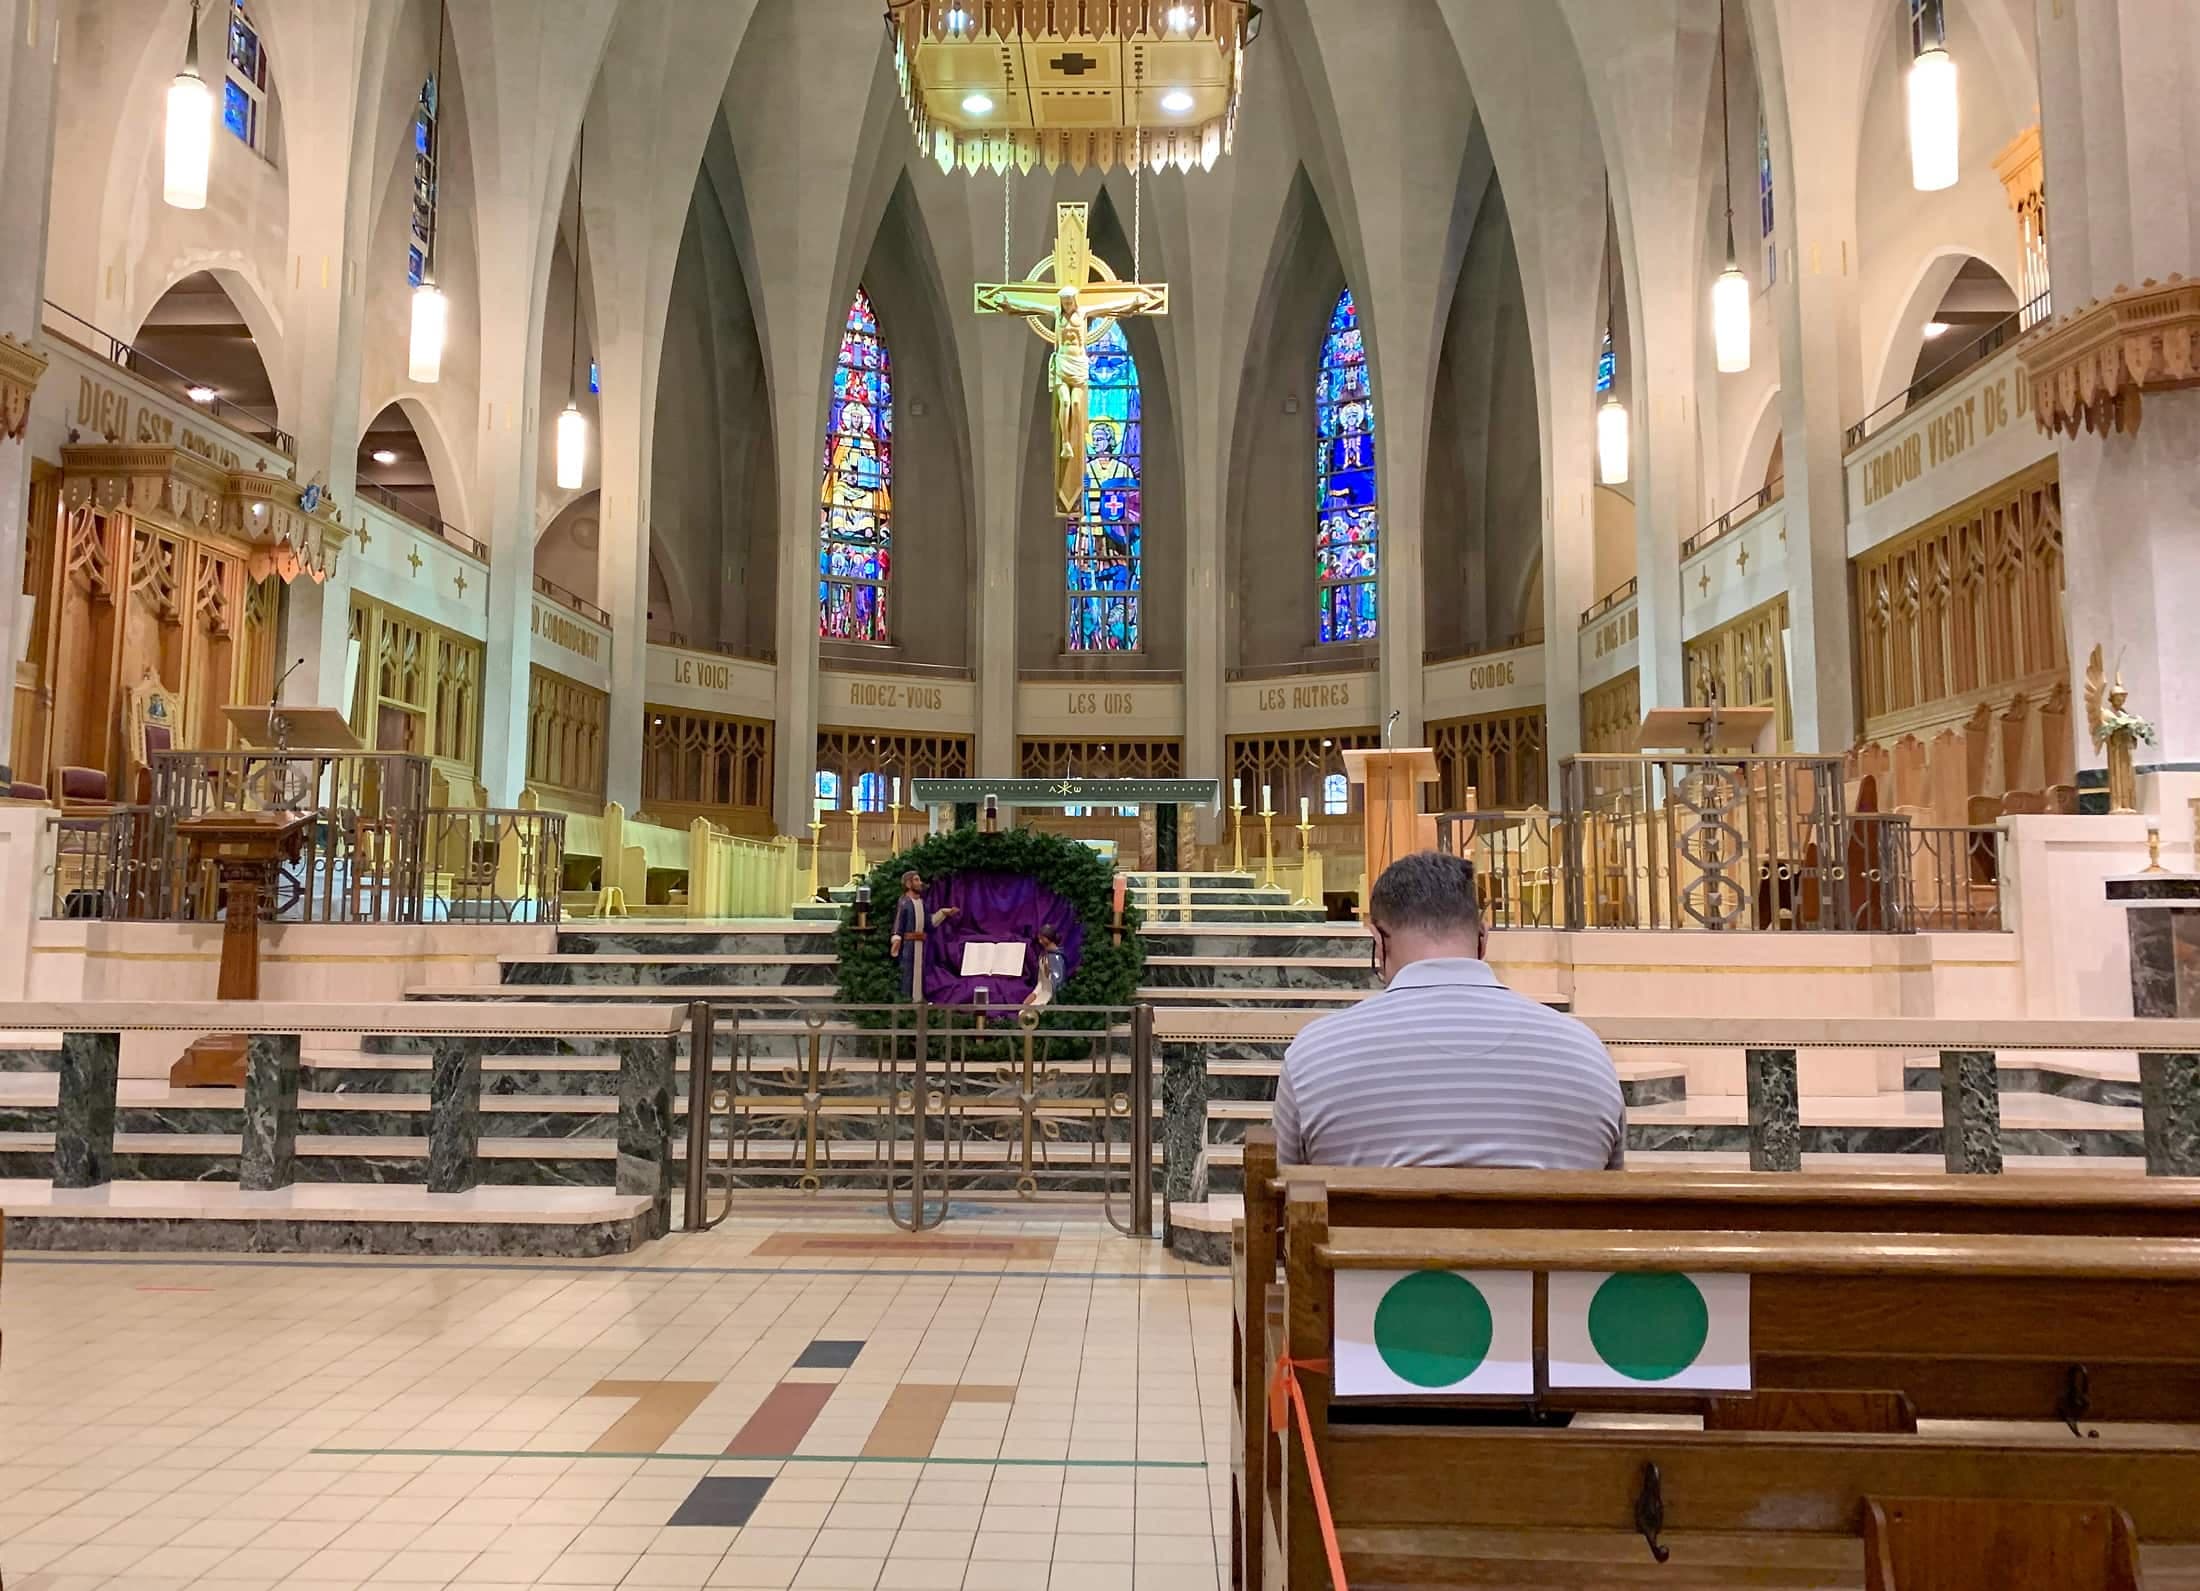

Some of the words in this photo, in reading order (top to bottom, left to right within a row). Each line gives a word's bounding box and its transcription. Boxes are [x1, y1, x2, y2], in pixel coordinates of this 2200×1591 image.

[78, 375, 128, 443] DIEU
[1928, 395, 1975, 468] VIENT
[1983, 377, 2008, 437] DE
[675, 658, 691, 684] LE
[1470, 660, 1514, 690] COMME
[850, 682, 942, 710] AIMEZ-VOUS
[1068, 692, 1096, 714] LES
[1104, 692, 1132, 714] UNS
[1259, 687, 1286, 711] LES
[1293, 682, 1349, 709] AUTRES
